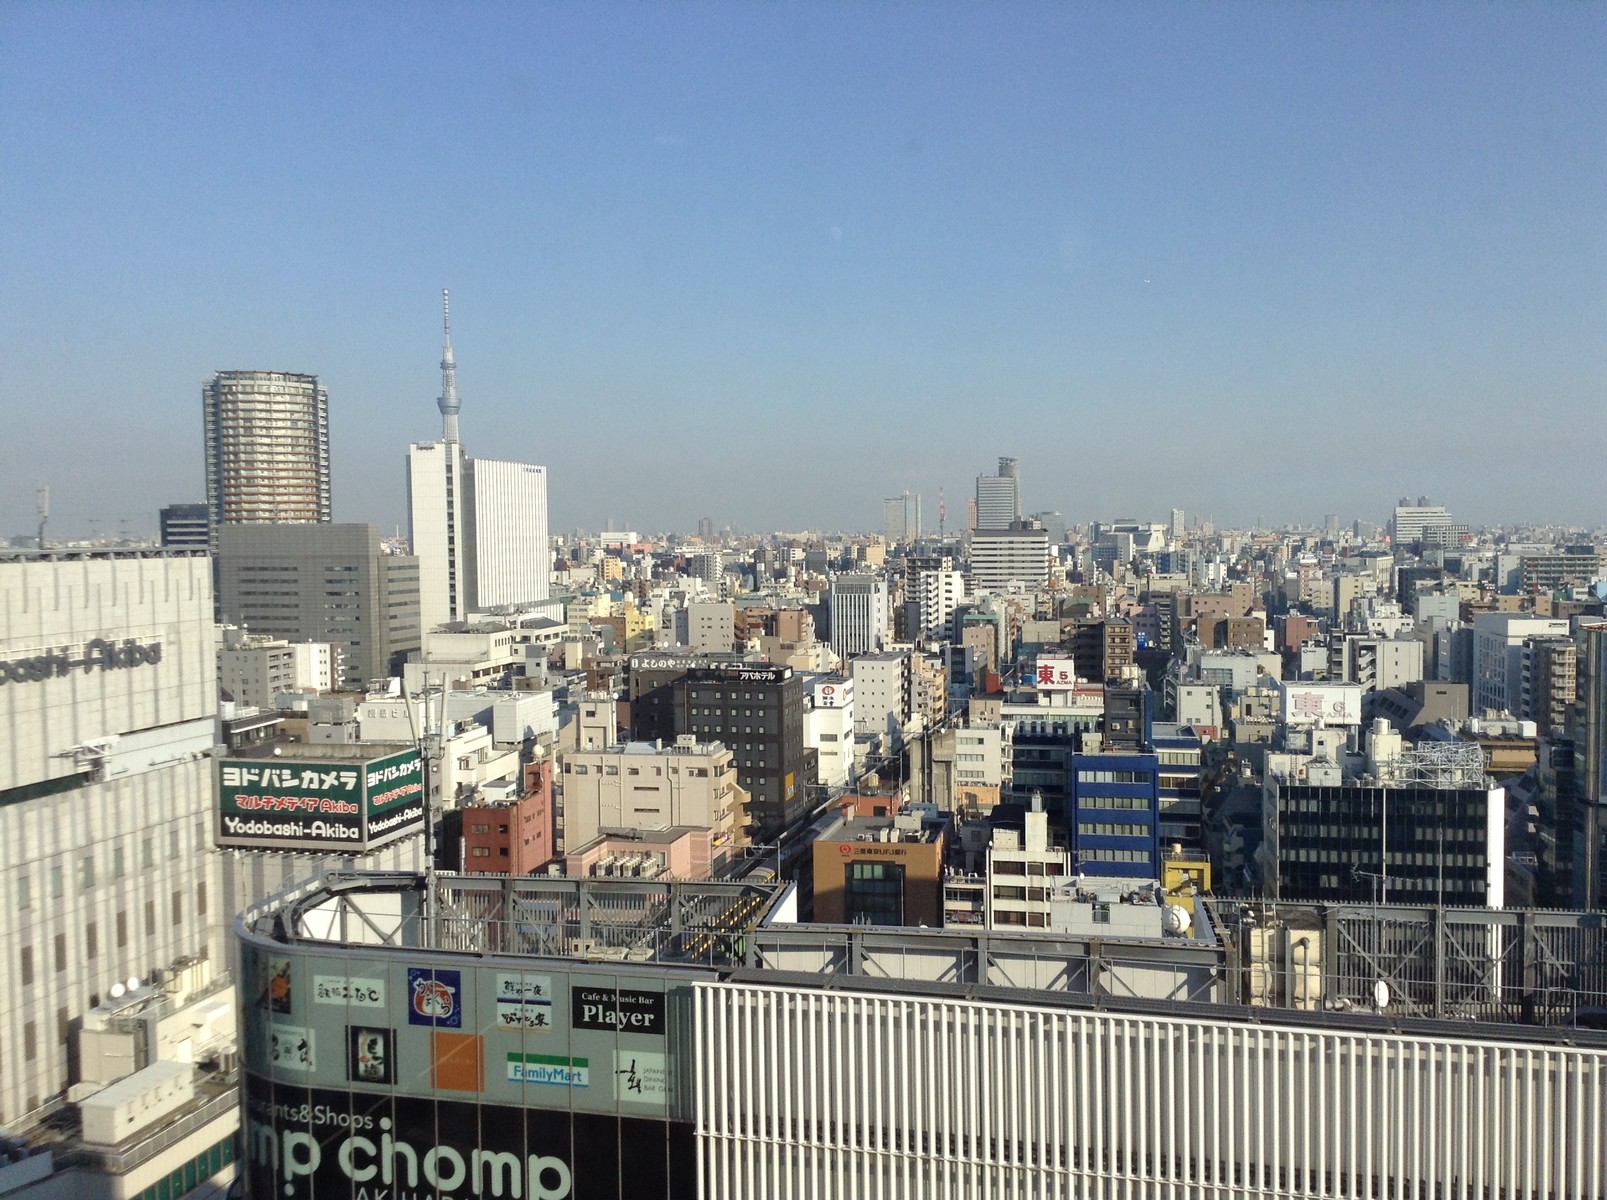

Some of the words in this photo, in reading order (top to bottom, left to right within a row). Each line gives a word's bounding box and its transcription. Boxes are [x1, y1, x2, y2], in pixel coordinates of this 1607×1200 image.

[739, 671, 776, 681] アパホテル
[1037, 664, 1055, 685] 東
[1059, 671, 1068, 680] 5
[1291, 691, 1324, 719] 東
[223, 767, 358, 790] ヨドバシカメラ
[367, 758, 421, 787] ヨドバシカメラ
[235, 795, 319, 811] マルチメディア
[320, 801, 359, 814] Akiba
[224, 817, 359, 839] Yodobashi-Akiba
[368, 807, 423, 834] Yodobashi-Akiba
[581, 992, 600, 1001] Cafe
[602, 994, 609, 1002] &
[611, 994, 637, 1004] Music
[638, 996, 654, 1005] Bar
[582, 1004, 655, 1029] Player
[513, 1064, 583, 1082] FamilyMart
[338, 1117, 572, 1200] chomp
